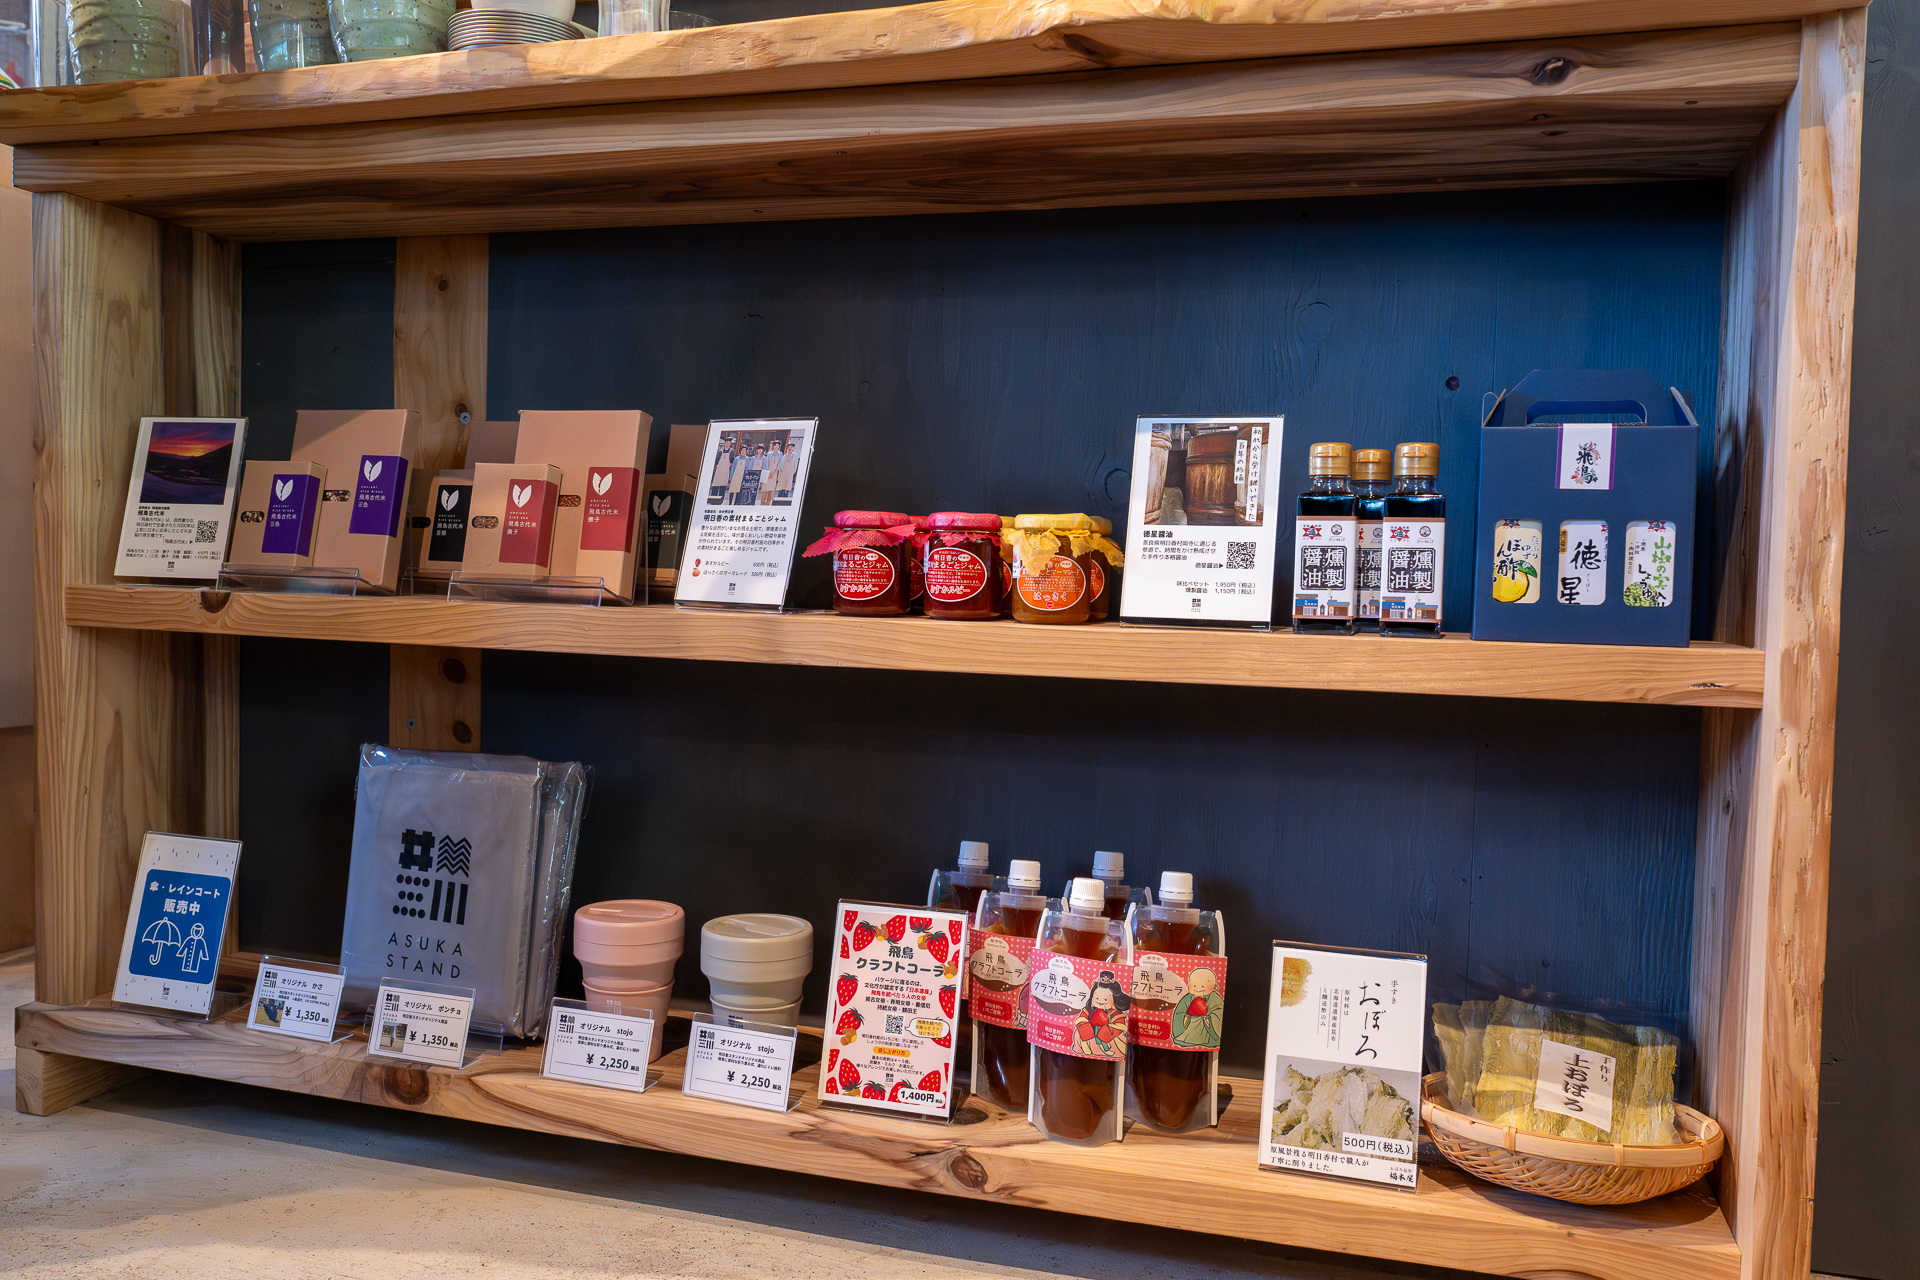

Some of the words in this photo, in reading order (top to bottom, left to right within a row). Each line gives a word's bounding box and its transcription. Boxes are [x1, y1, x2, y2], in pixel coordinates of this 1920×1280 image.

[1576, 446, 1596, 484] 飛鳥
[1143, 530, 1173, 538] 徳星醤油
[1303, 548, 1322, 586] 醤油
[1324, 548, 1344, 587] 燻製
[1390, 551, 1410, 589] 醤油
[1413, 550, 1432, 589] 燻製
[1560, 539, 1601, 604] 徳星
[1638, 564, 1652, 598] しょうゆ
[150, 880, 220, 899] 傘・レインコート
[163, 898, 201, 916] 販売中
[388, 932, 463, 957] ASUKA
[888, 945, 914, 960] 飛鳥
[386, 954, 461, 979] STAND
[856, 957, 944, 977] クラフトコーラ
[986, 952, 1005, 965] 飛鳥
[973, 960, 1022, 978] クラフトコーラ
[1141, 970, 1164, 983] 飛鳥
[281, 978, 307, 987] オリジナル
[1049, 973, 1069, 987] 飛鳥
[1133, 982, 1183, 995] ラフトコーラ
[1034, 982, 1086, 1001] クラフトコーラ
[1390, 980, 1398, 1004] 手すき
[285, 1006, 292, 1016] ¥
[296, 1010, 320, 1022] 1,350
[404, 1001, 432, 1011] オリジナル
[438, 1006, 461, 1015] ポンチョ
[580, 1023, 611, 1033] オリジナル
[617, 1028, 633, 1036] stojo
[1355, 981, 1386, 1060] おぼろ
[409, 1030, 417, 1041] ¥
[421, 1034, 448, 1046] 1,350
[1044, 1026, 1064, 1036] 明日香村の
[720, 1039, 751, 1050] オリジナル
[758, 1046, 774, 1054] stojo
[586, 1053, 594, 1064] ¥
[600, 1056, 628, 1069] 2,250
[1600, 1057, 1611, 1082] 手作り
[727, 1070, 735, 1082] ¥
[741, 1074, 770, 1088] 2,250
[1564, 1053, 1590, 1112] 上おぼろ
[901, 1091, 934, 1103] 1,400円
[1270, 1146, 1370, 1166] 原風景残る明日香村で職人が
[1270, 1156, 1333, 1172] 丁寧に削りました。
